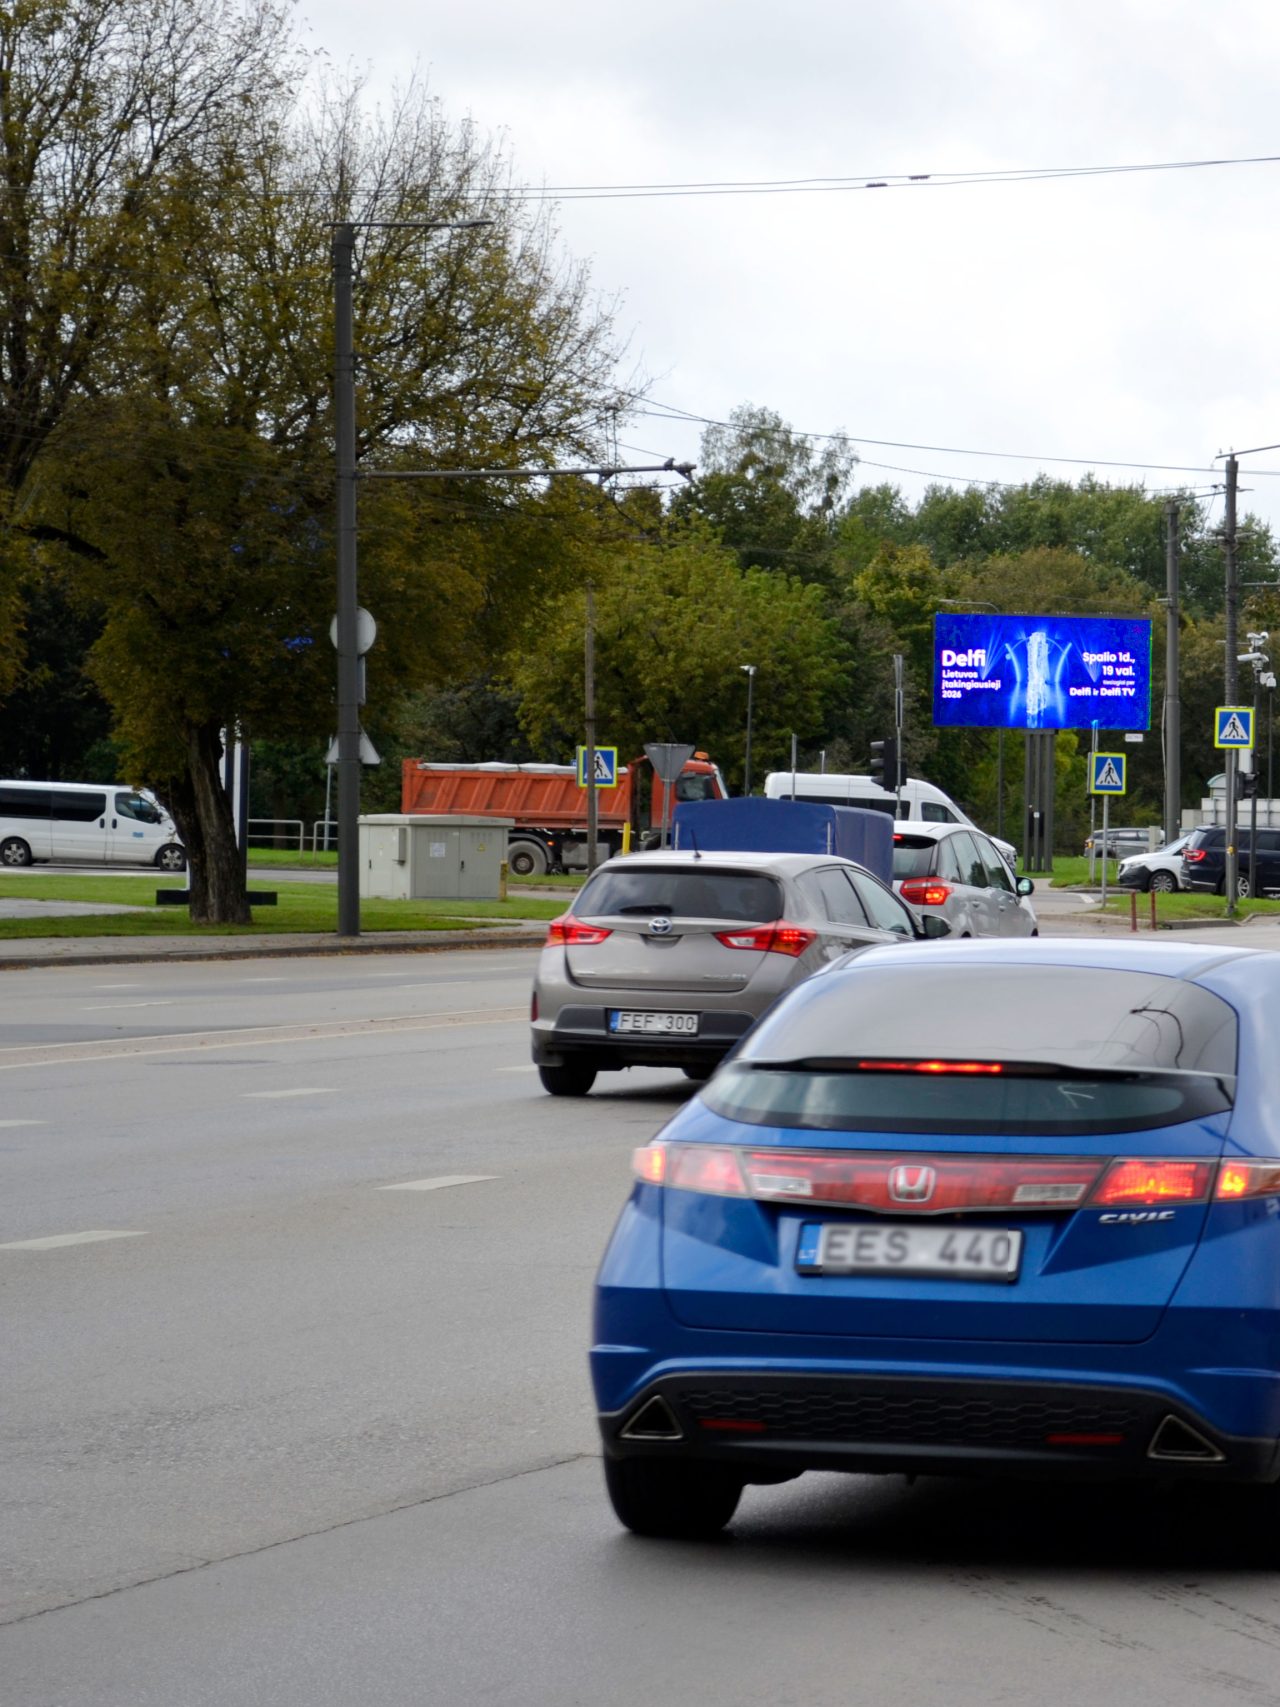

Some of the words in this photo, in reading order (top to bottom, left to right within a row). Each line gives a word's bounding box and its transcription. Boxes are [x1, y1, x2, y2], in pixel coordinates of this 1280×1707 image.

[942, 649, 986, 667] Delfi
[1083, 651, 1117, 665] Spalio
[942, 669, 978, 678] Lietuvos
[1102, 665, 1114, 676] 19
[1115, 665, 1136, 676] val.
[1069, 687, 1091, 696] Delfi
[1092, 688, 1099, 696] ir
[1100, 687, 1121, 696] Delfi
[1122, 687, 1136, 696] TV
[620, 1013, 655, 1029] FEF
[665, 1015, 695, 1031] 300
[1098, 1210, 1176, 1225] CIVIC
[824, 1228, 909, 1264] EES
[937, 1232, 1013, 1268] 440
